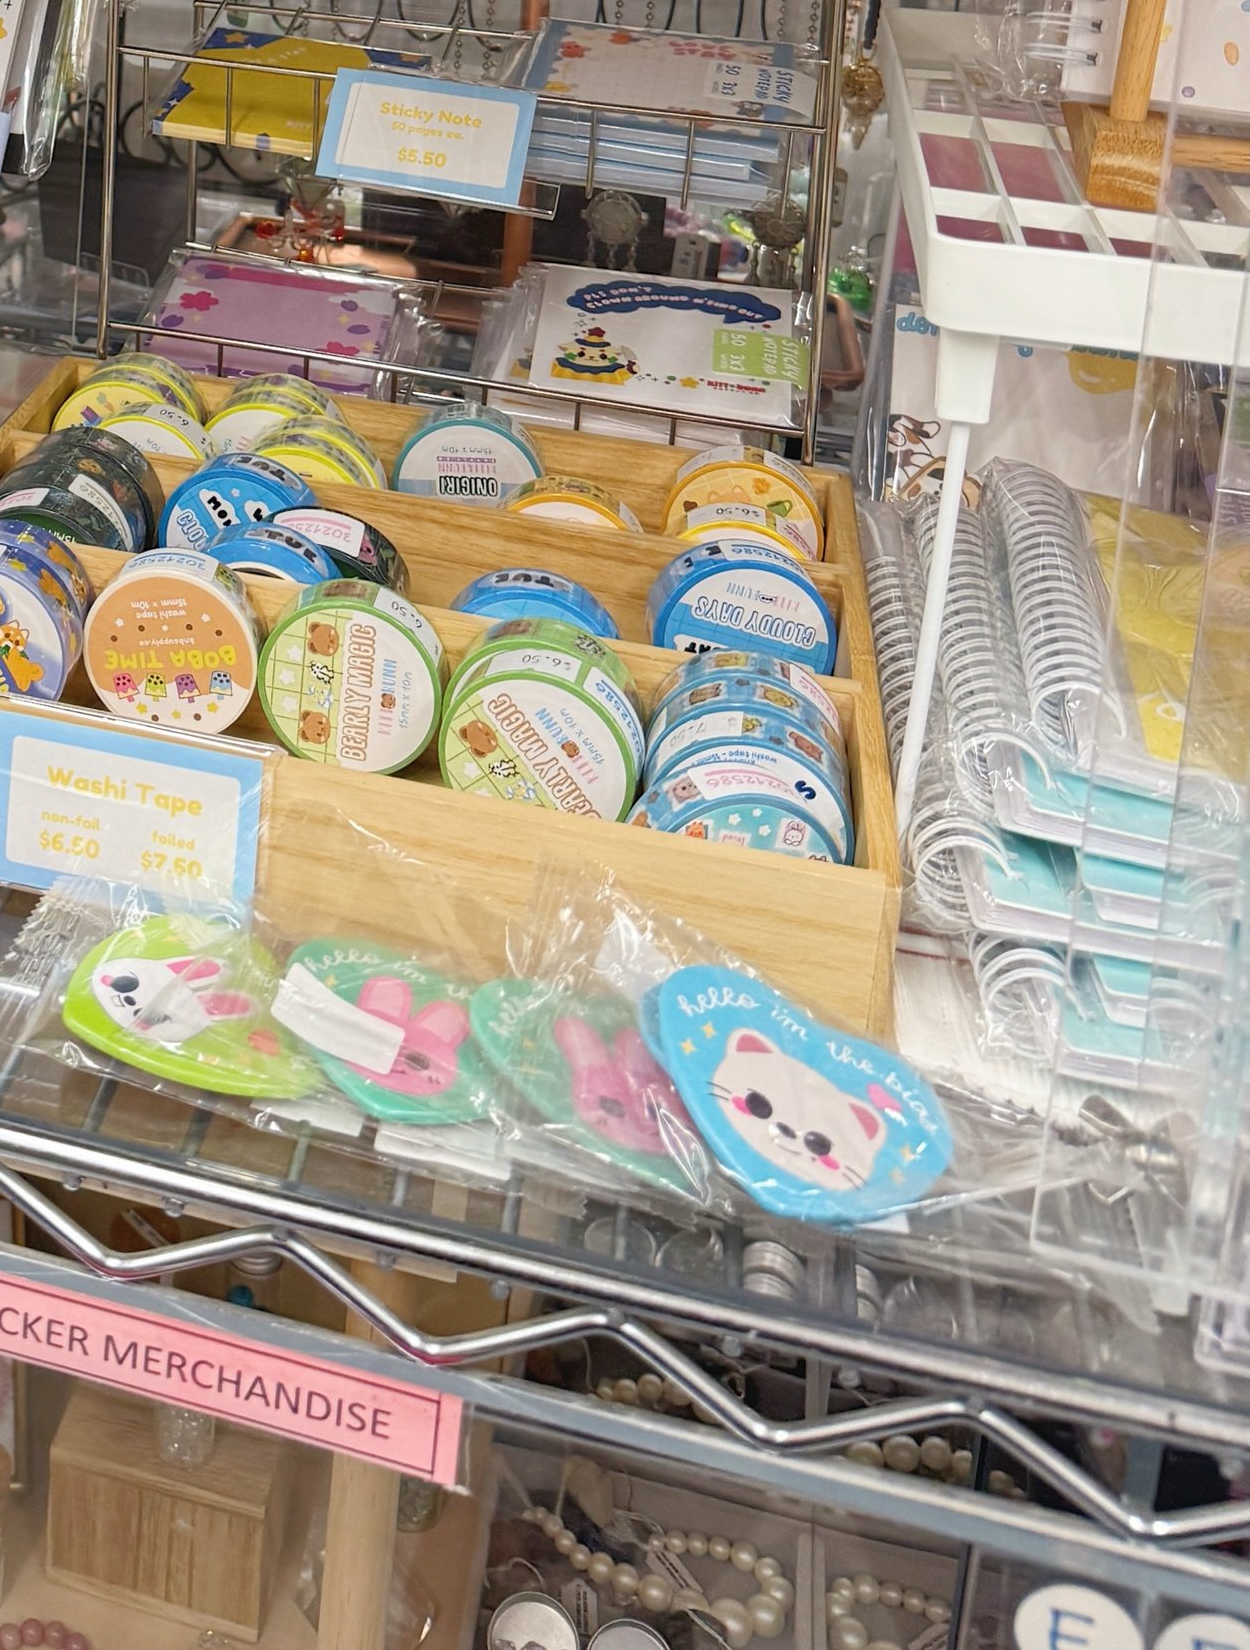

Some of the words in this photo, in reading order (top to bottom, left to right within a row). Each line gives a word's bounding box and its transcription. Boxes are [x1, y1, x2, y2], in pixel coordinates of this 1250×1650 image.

[773, 69, 795, 104] STICKY
[379, 100, 434, 122] Sticky
[438, 106, 484, 128] Note
[407, 125, 443, 139] pages
[397, 145, 448, 169] $5.50
[761, 335, 778, 375] NOTEPAD
[781, 338, 800, 382] STICKY
[236, 455, 286, 482] TUE
[438, 475, 499, 497] ONIGIRI
[264, 528, 318, 563] TUE
[494, 572, 556, 589] TUE
[130, 600, 150, 610] 10m
[135, 610, 158, 620] tape
[159, 610, 187, 620] washi
[160, 597, 188, 607] 15mm
[693, 595, 745, 627] DAYS
[138, 637, 196, 648] knbsupply.co
[744, 611, 818, 647] CLOUDY
[103, 648, 165, 671] TIME
[168, 643, 238, 671] BOBA
[346, 622, 378, 689] MAGIC
[381, 658, 398, 694] BUNN
[339, 689, 372, 763] BEARLY
[487, 692, 550, 763] MAGIC
[534, 707, 569, 747] BUNN
[729, 749, 751, 759] tape
[751, 751, 778, 765] washi
[47, 765, 129, 801] Washi
[134, 782, 203, 818] Tape
[41, 810, 101, 832] non-foil
[39, 829, 101, 860] $6.50
[151, 830, 196, 851] foiled
[141, 849, 203, 879] $7.50
[311, 949, 381, 974] hello
[678, 986, 761, 1018] hello
[771, 1007, 812, 1043] i'm
[826, 1040, 876, 1075] the
[103, 1334, 394, 1441] MERCHANDISE
